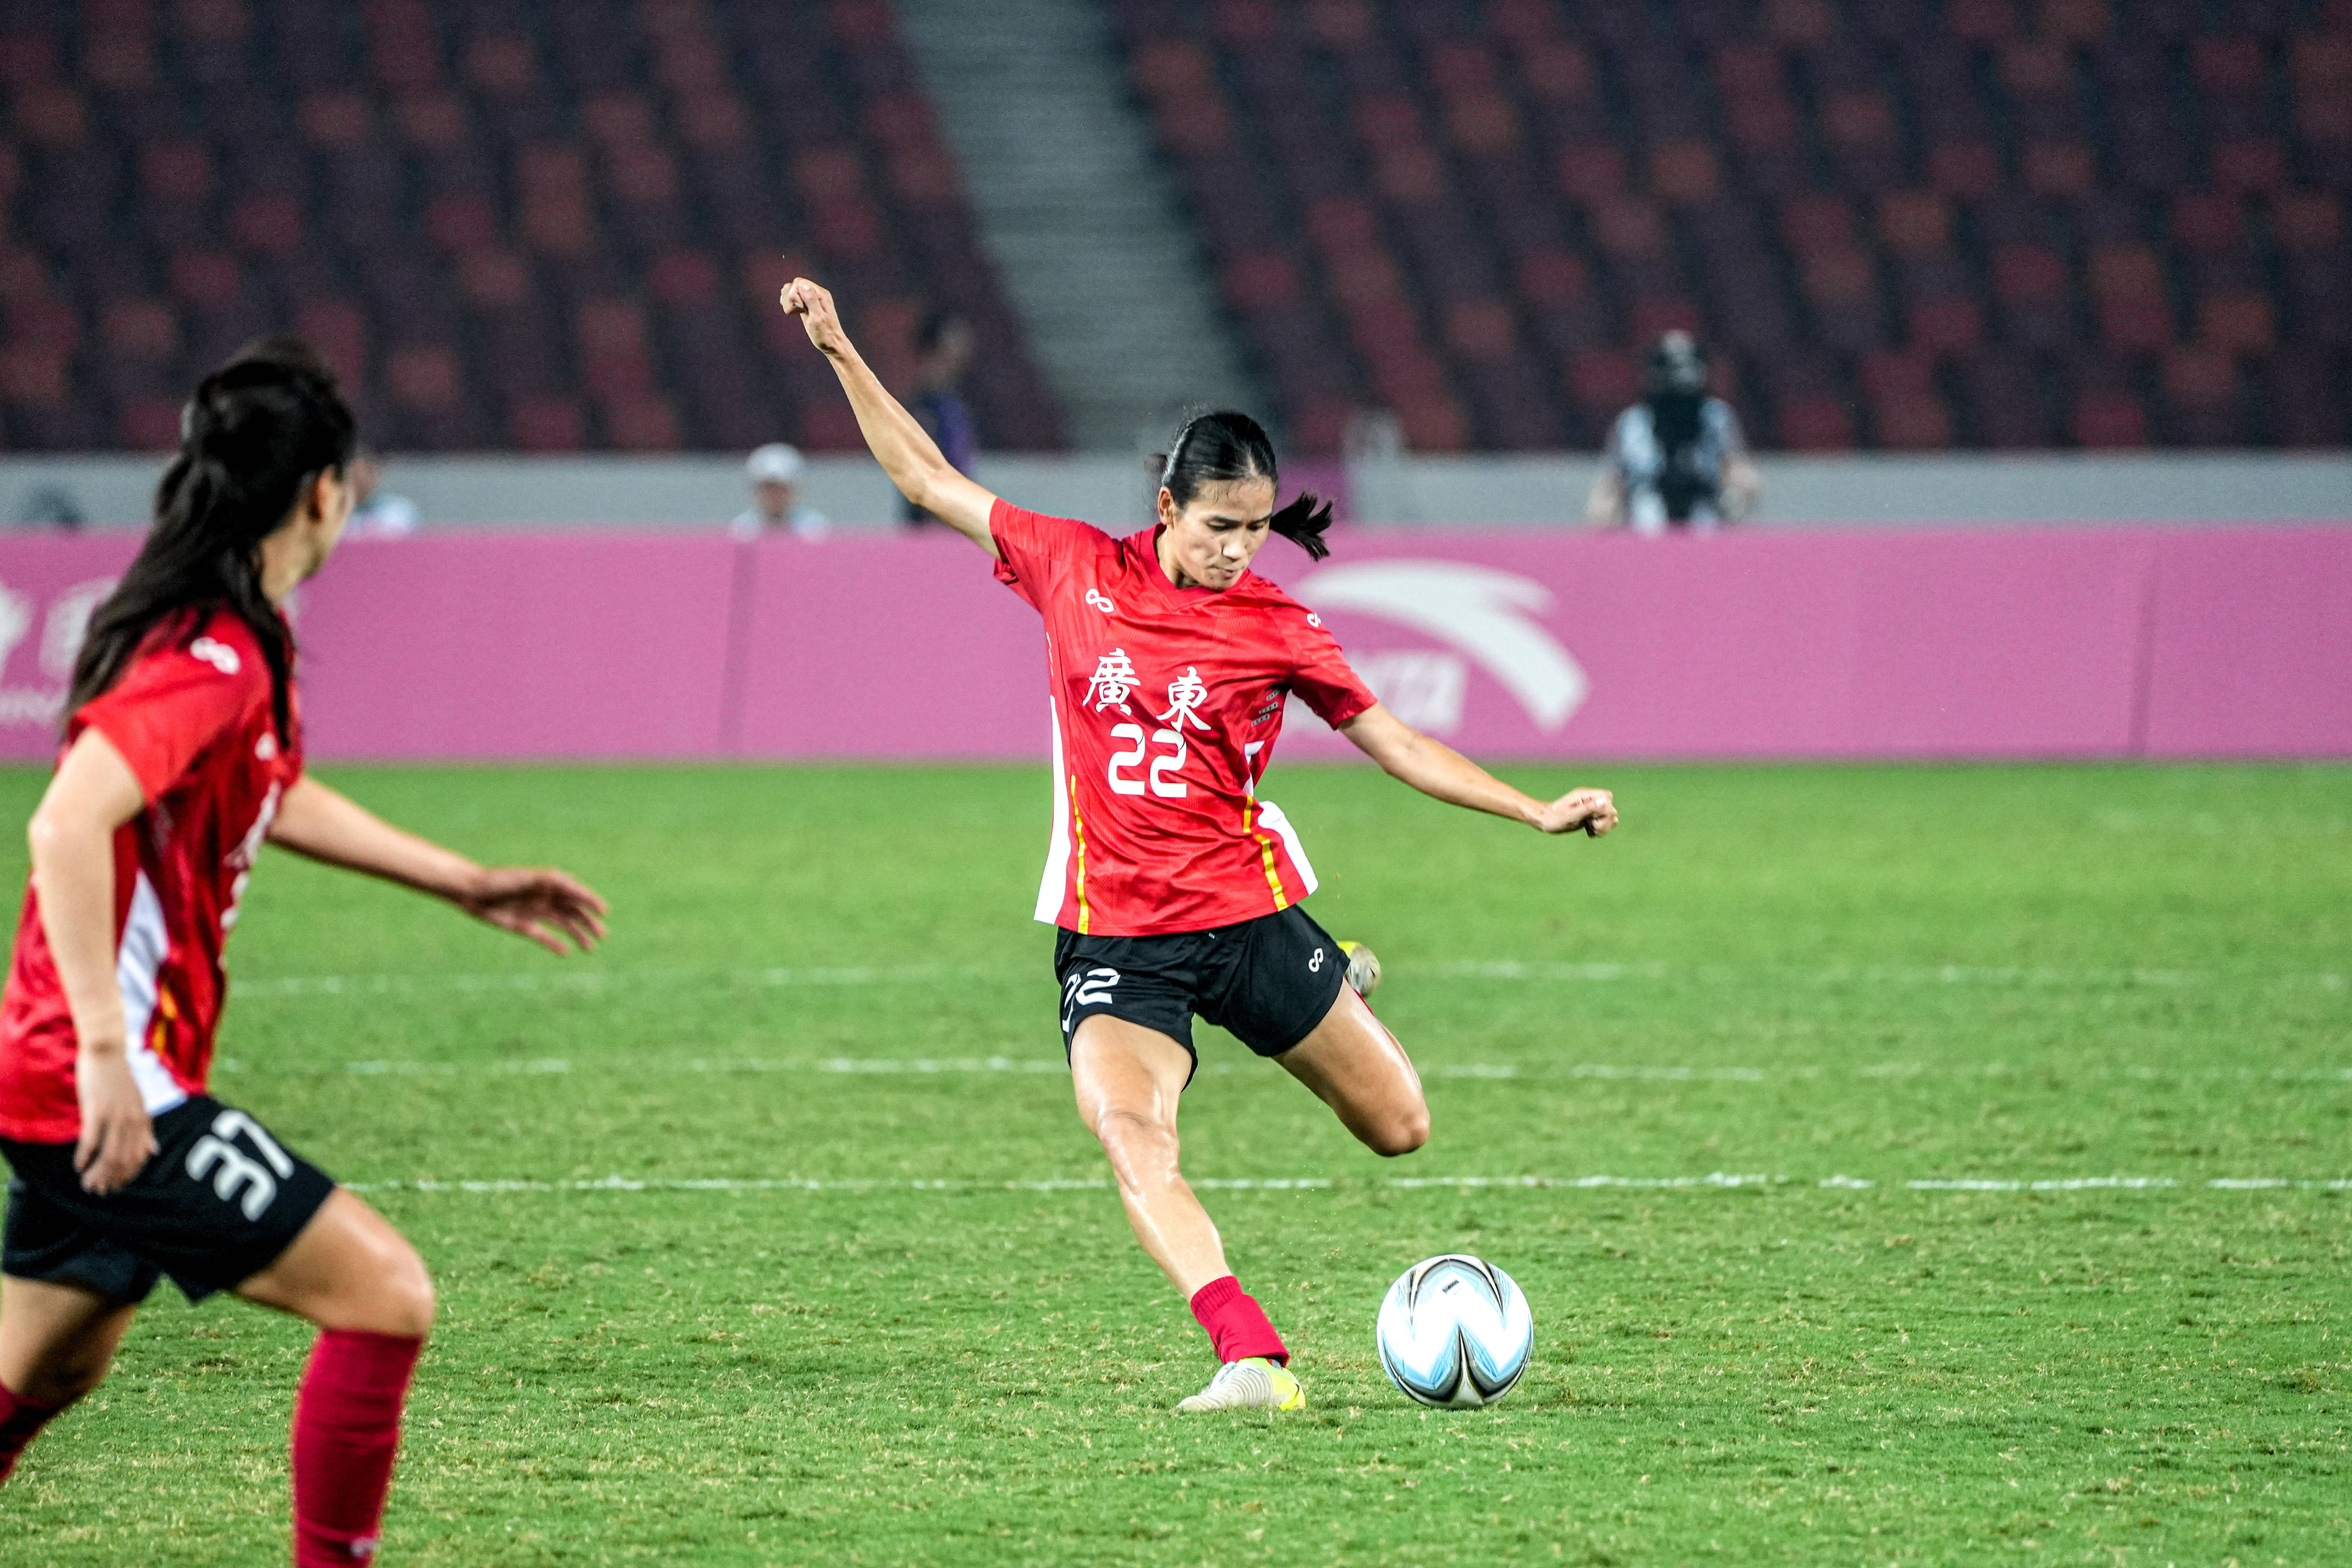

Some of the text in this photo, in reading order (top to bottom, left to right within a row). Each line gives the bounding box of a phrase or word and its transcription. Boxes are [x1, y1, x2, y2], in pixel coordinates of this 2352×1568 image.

[1082, 647, 1211, 733] 廣東
[1108, 723, 1187, 798] 22
[185, 1109, 295, 1221] 37
